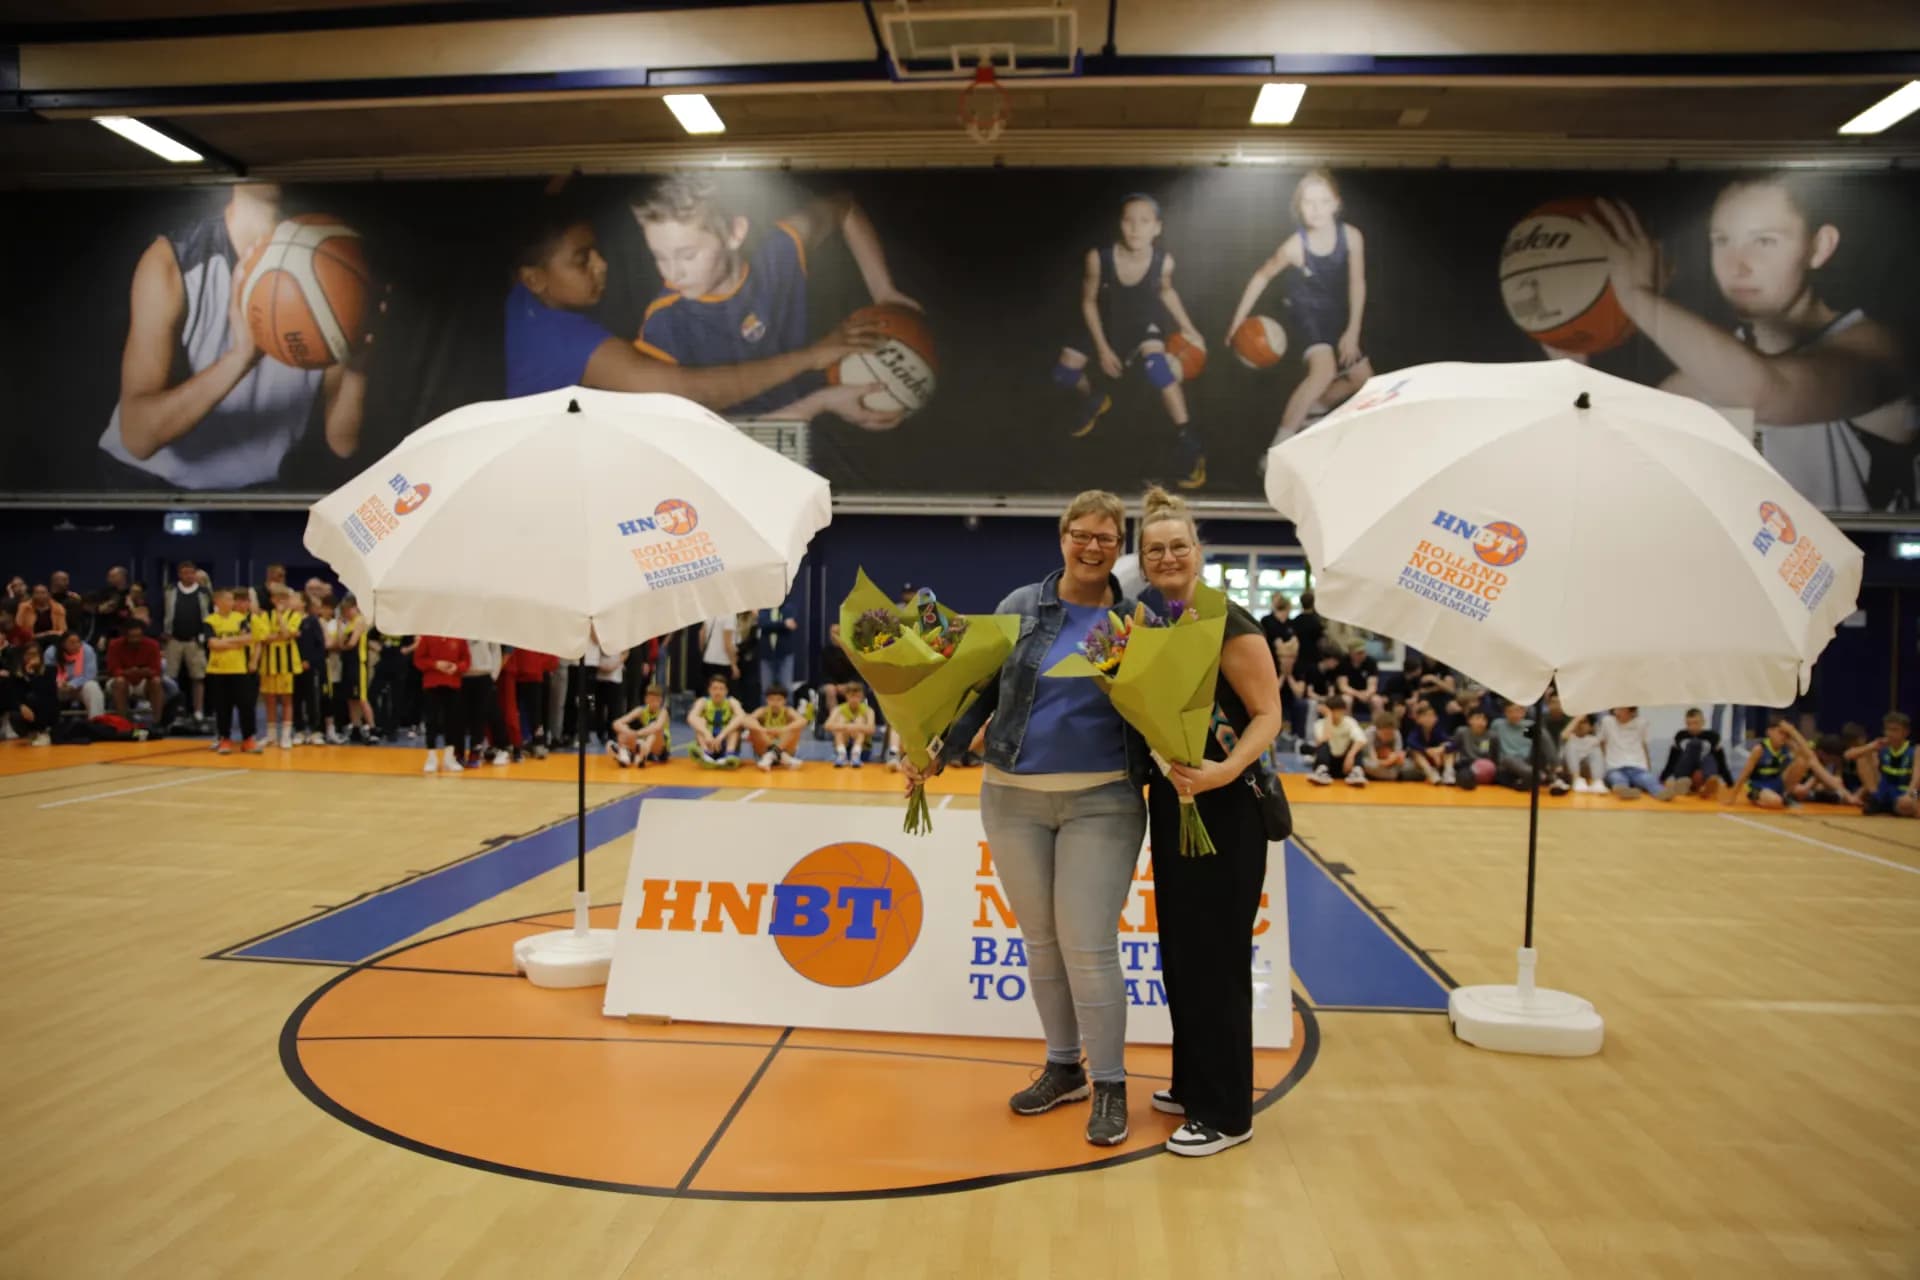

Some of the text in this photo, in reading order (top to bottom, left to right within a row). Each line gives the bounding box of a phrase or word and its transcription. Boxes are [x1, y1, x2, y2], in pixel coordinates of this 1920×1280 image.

[617, 506, 690, 536] HNBT
[1431, 510, 1518, 557] HNBT
[638, 543, 717, 571] NORDIC
[644, 555, 722, 581] BASKETBALL
[648, 563, 725, 591] TOURNAMENT
[1408, 551, 1501, 601] NORDIC
[1417, 539, 1508, 587] HOLLAND
[1398, 576, 1487, 622] TOURNAMENT
[1402, 566, 1491, 613] BASKETBALL
[636, 879, 892, 940] HNBT
